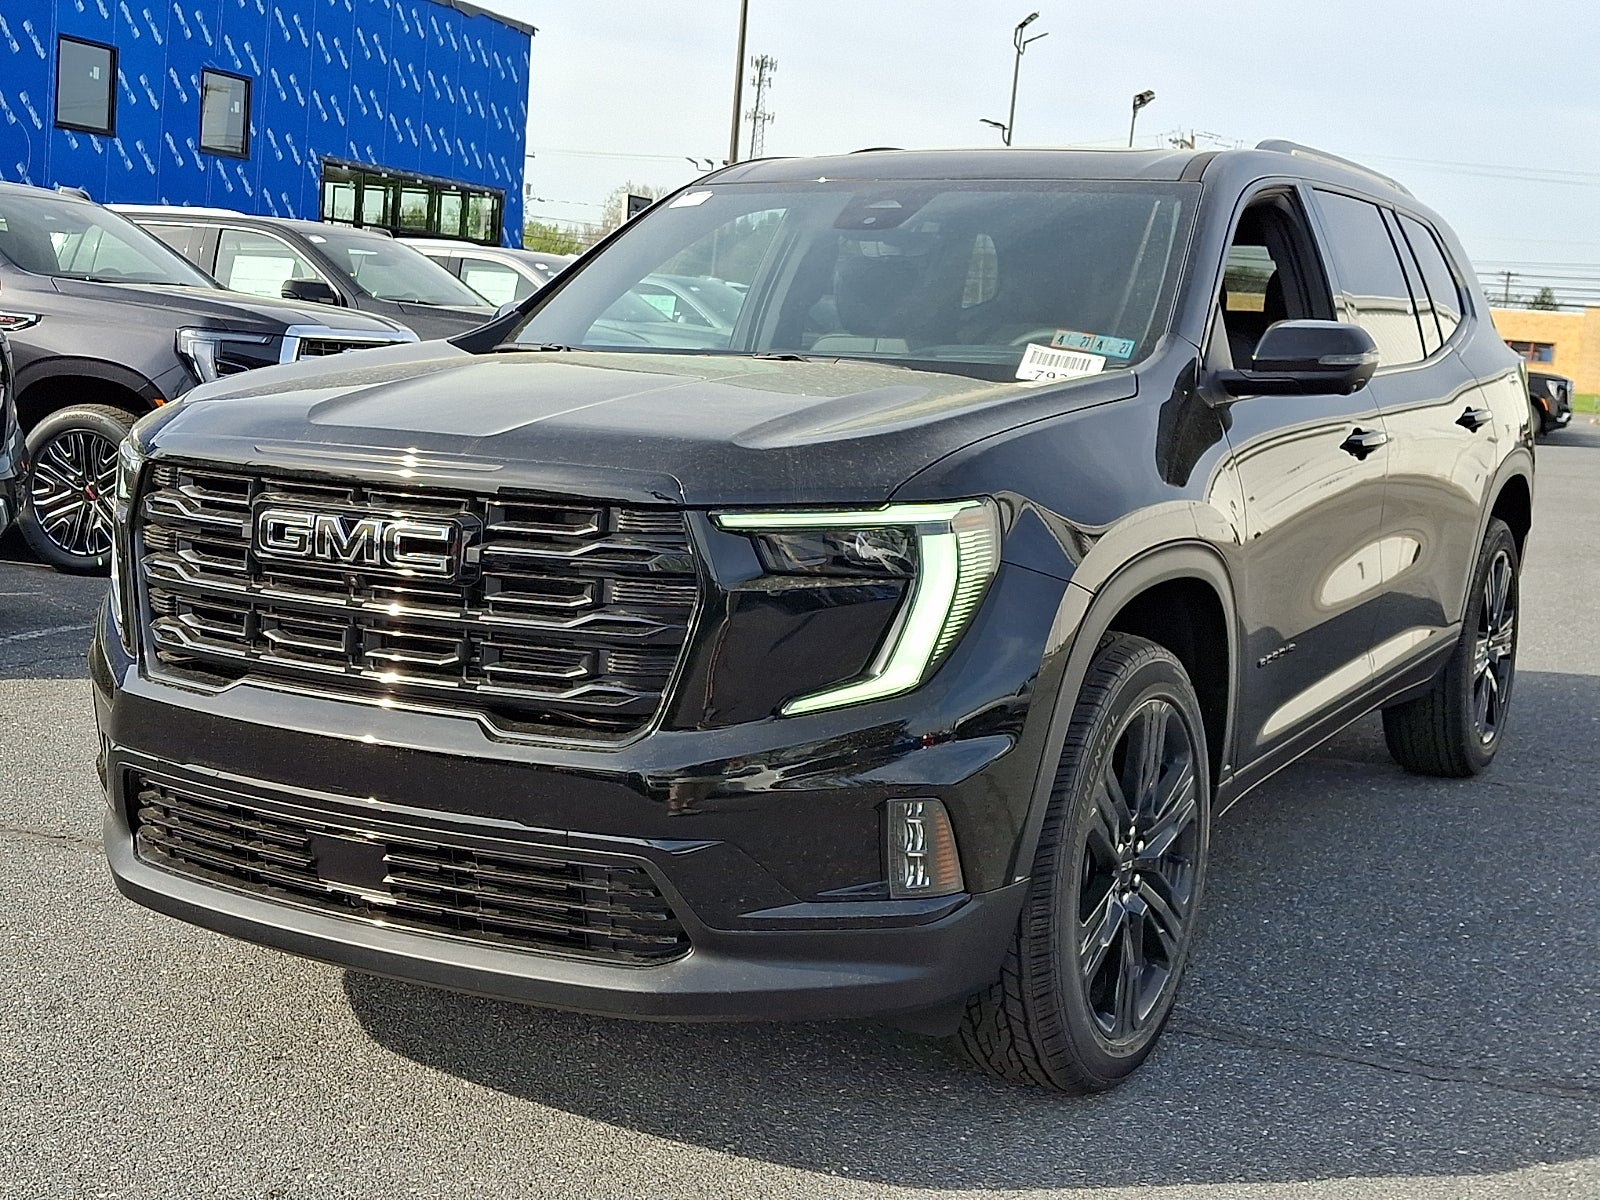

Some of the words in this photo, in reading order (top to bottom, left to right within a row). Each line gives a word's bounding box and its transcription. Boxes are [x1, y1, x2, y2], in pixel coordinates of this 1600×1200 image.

[1080, 336, 1091, 348] 27
[1119, 342, 1130, 353] 27
[1034, 370, 1068, 379] 79
[258, 509, 454, 573] GMC
